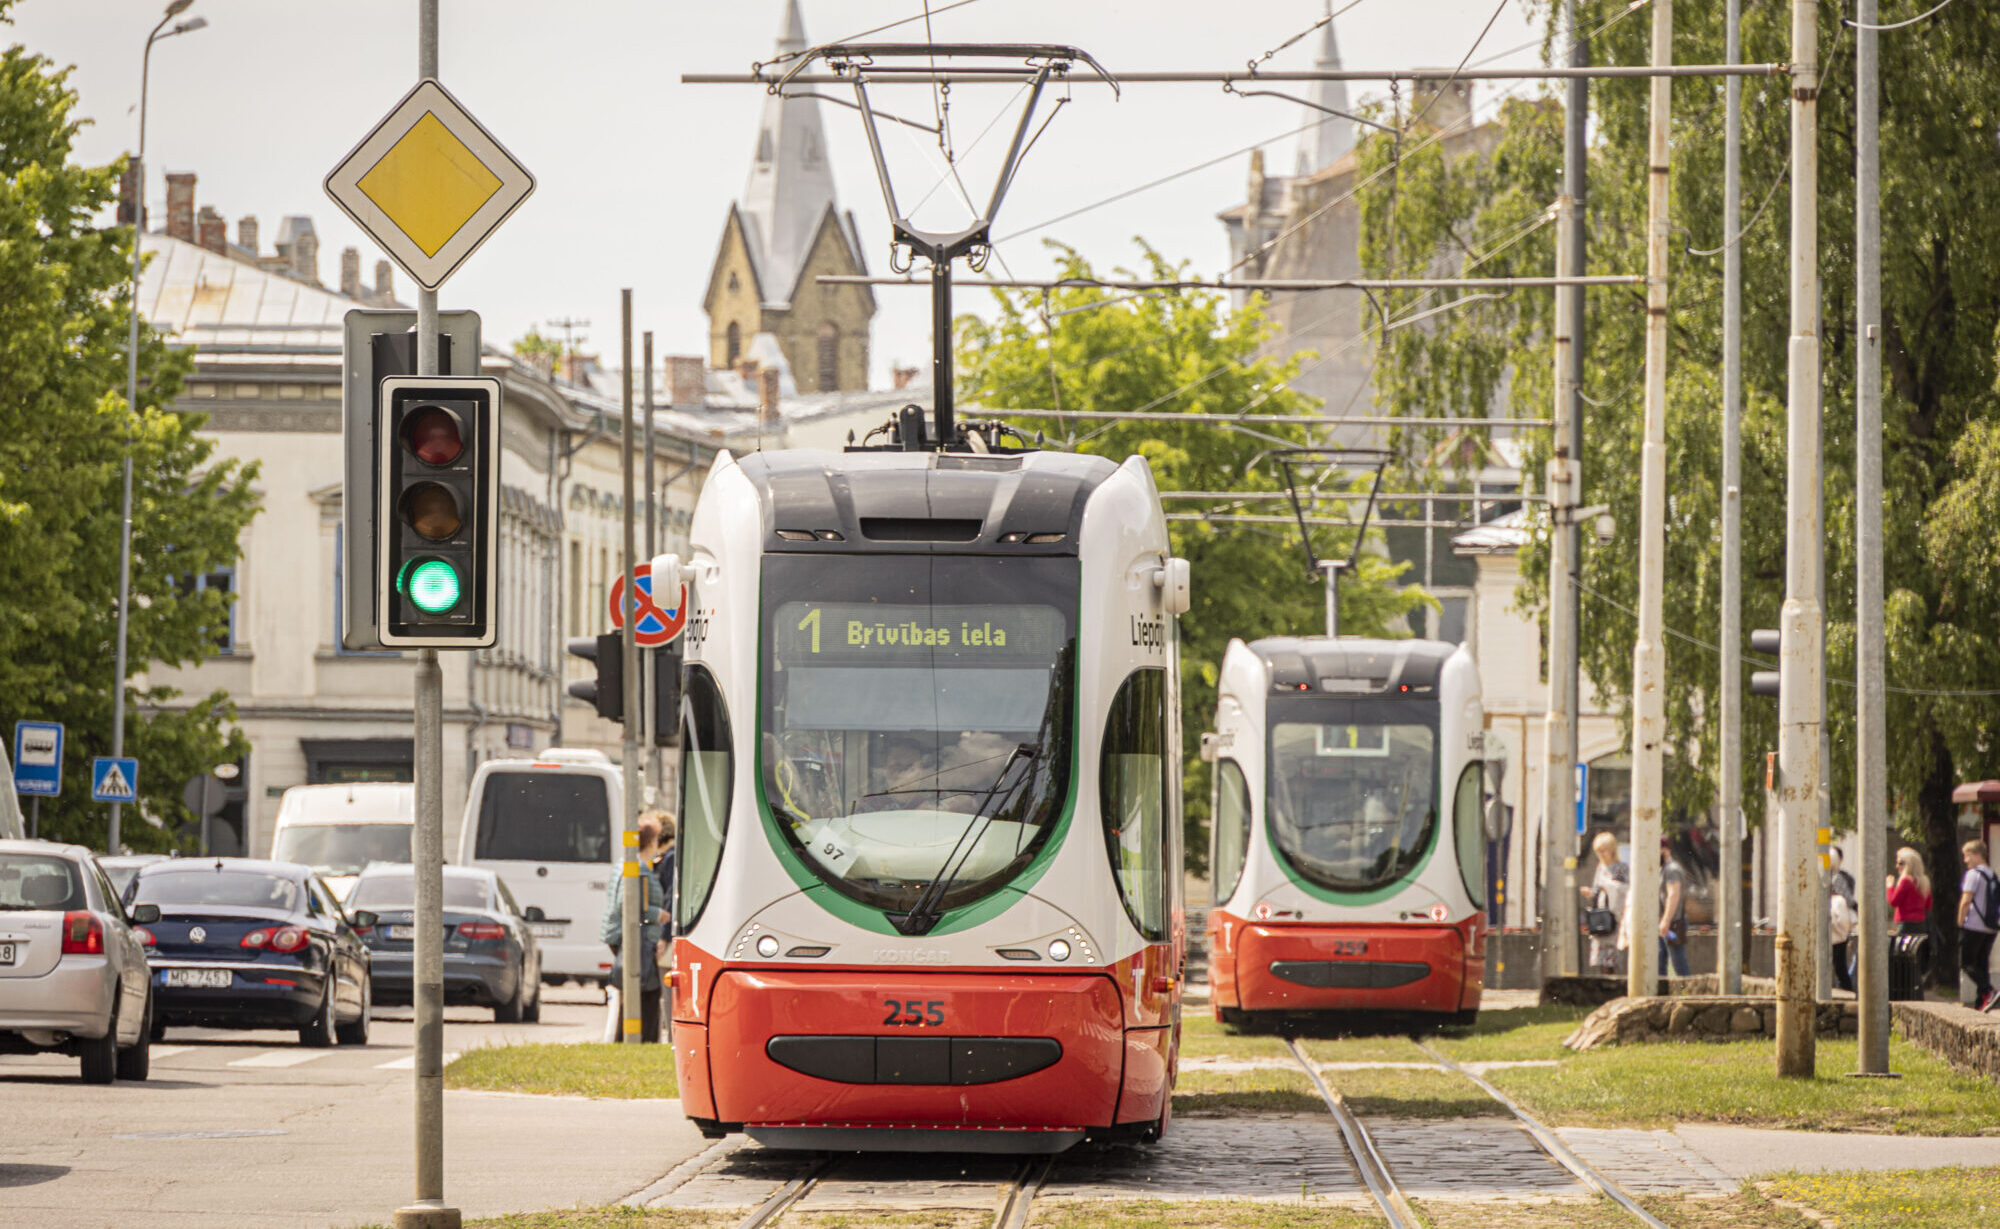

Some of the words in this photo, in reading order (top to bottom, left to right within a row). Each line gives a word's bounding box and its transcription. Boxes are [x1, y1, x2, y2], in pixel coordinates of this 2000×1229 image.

[798, 608, 821, 653] 1
[848, 621, 950, 645] Brīvības
[961, 622, 1006, 646] iela
[1346, 725, 1358, 749] 1
[824, 842, 844, 860] 97
[883, 1000, 945, 1026] 255
